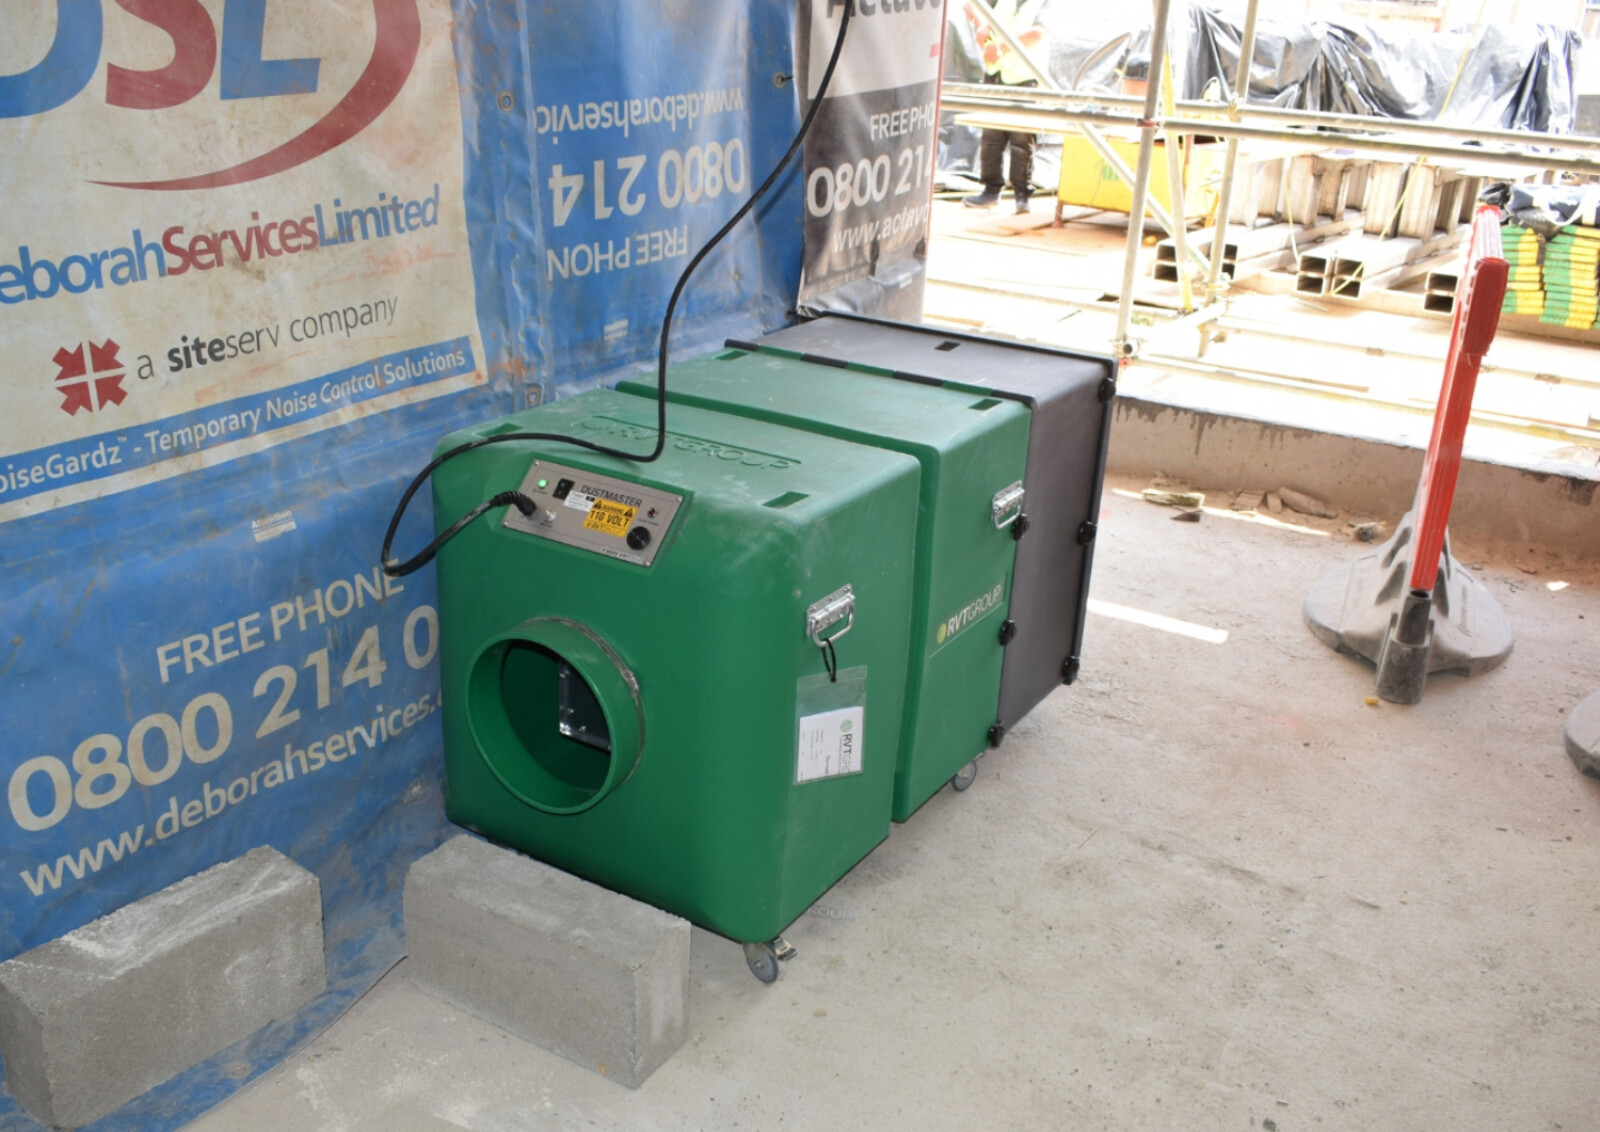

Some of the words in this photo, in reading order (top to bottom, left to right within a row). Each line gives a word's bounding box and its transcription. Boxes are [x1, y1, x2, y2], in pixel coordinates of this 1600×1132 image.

[532, 87, 744, 145] www.deborahservic
[870, 107, 909, 141] FREE
[548, 154, 647, 228] 214
[658, 138, 745, 209] 0800
[807, 154, 891, 218] 0800
[636, 225, 688, 266] FREE
[136, 353, 155, 380] a
[167, 321, 281, 373] siteserv
[289, 296, 399, 343] company
[145, 406, 261, 457] Temporary
[266, 389, 317, 423] Noise
[320, 365, 382, 404] Control
[383, 348, 466, 386] Solutions
[581, 484, 643, 508] DUSTMASTER
[589, 509, 606, 523] 110
[606, 513, 631, 529] VOLT
[946, 583, 1002, 637] RVTGROUP
[156, 612, 262, 684] FREE
[8, 691, 234, 832] 0800
[252, 624, 388, 740] 214
[403, 604, 439, 670] 0
